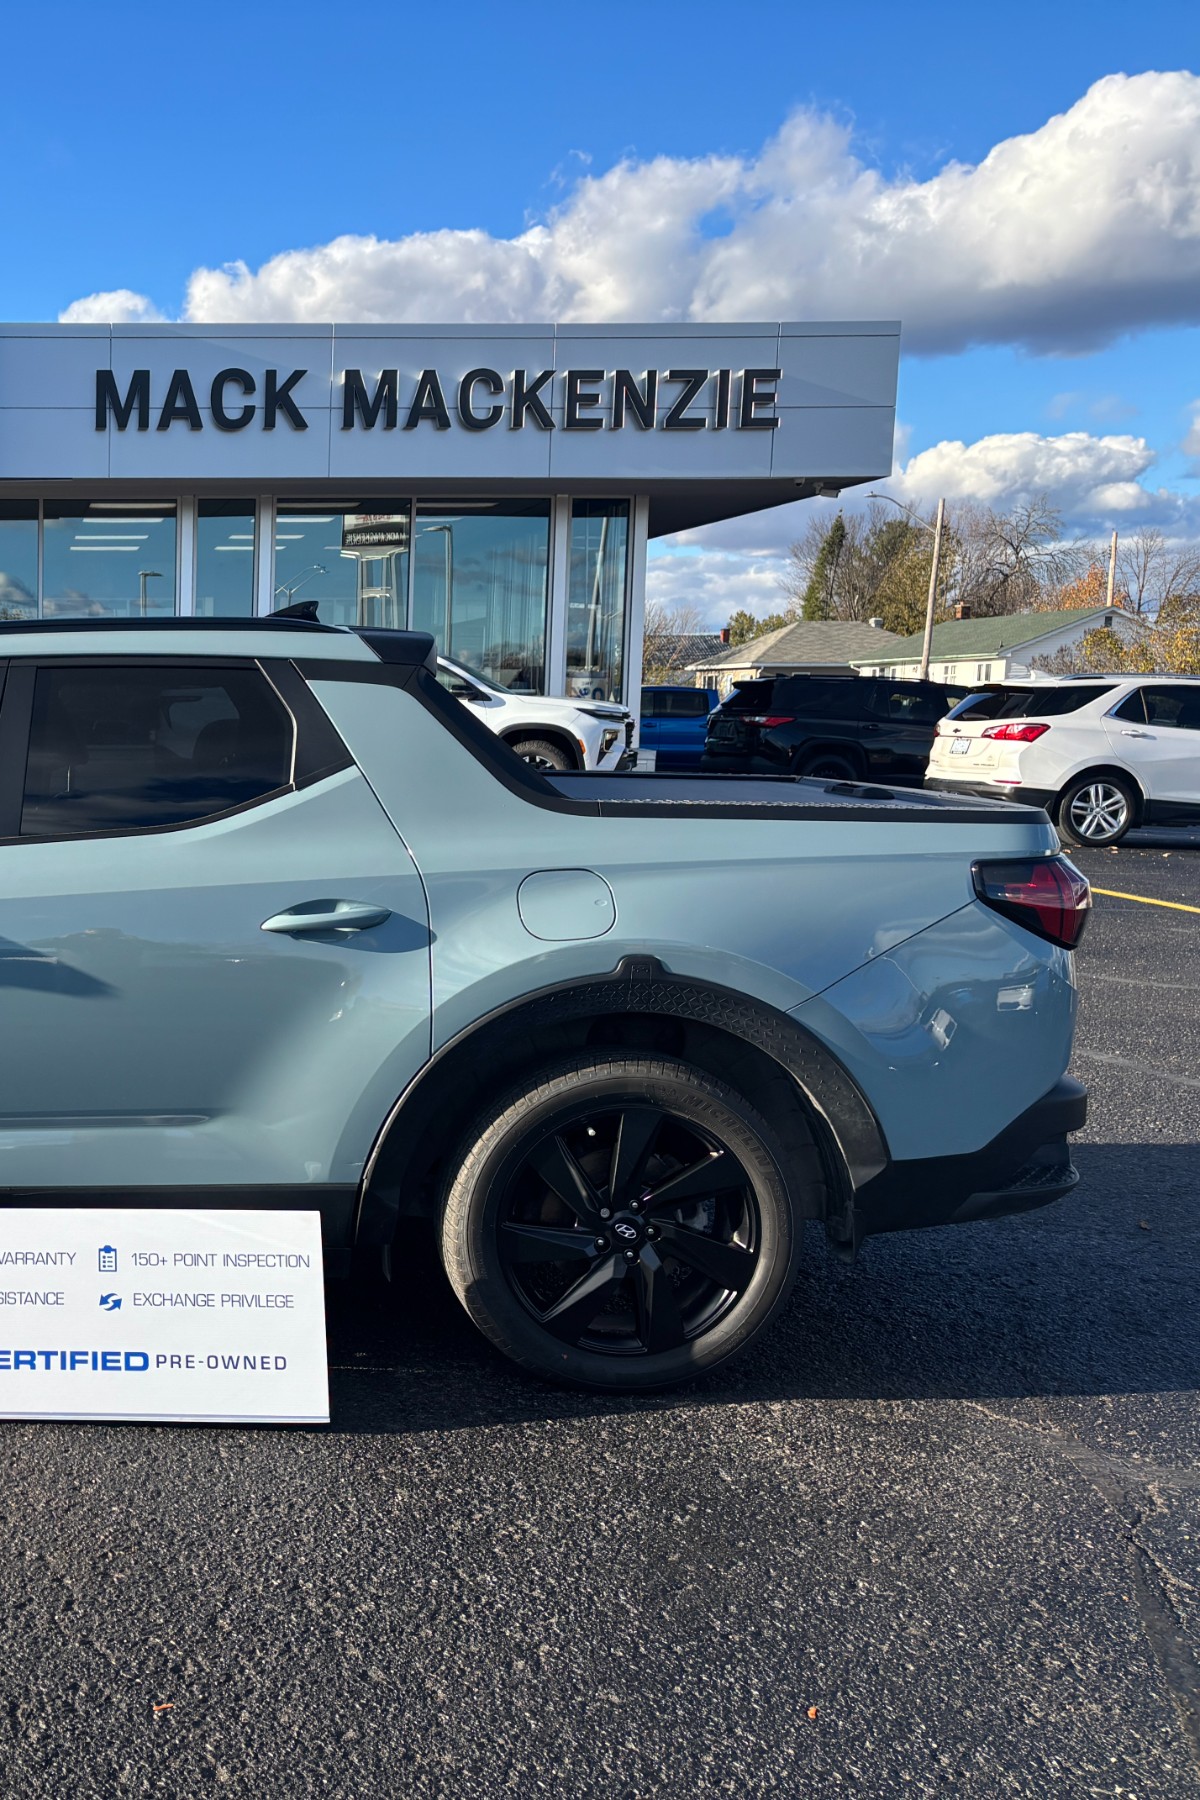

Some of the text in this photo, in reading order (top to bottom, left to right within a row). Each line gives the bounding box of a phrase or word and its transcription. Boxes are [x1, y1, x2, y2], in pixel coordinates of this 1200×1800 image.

[95, 368, 782, 431] MACK MACKENZIE
[682, 1092, 771, 1168] MICHELIN
[131, 1252, 310, 1268] 150+ POINT INSPECTION
[133, 1293, 295, 1309] EXCHANGE PRIVILEGE
[156, 1354, 287, 1371] PRE-OWNED
